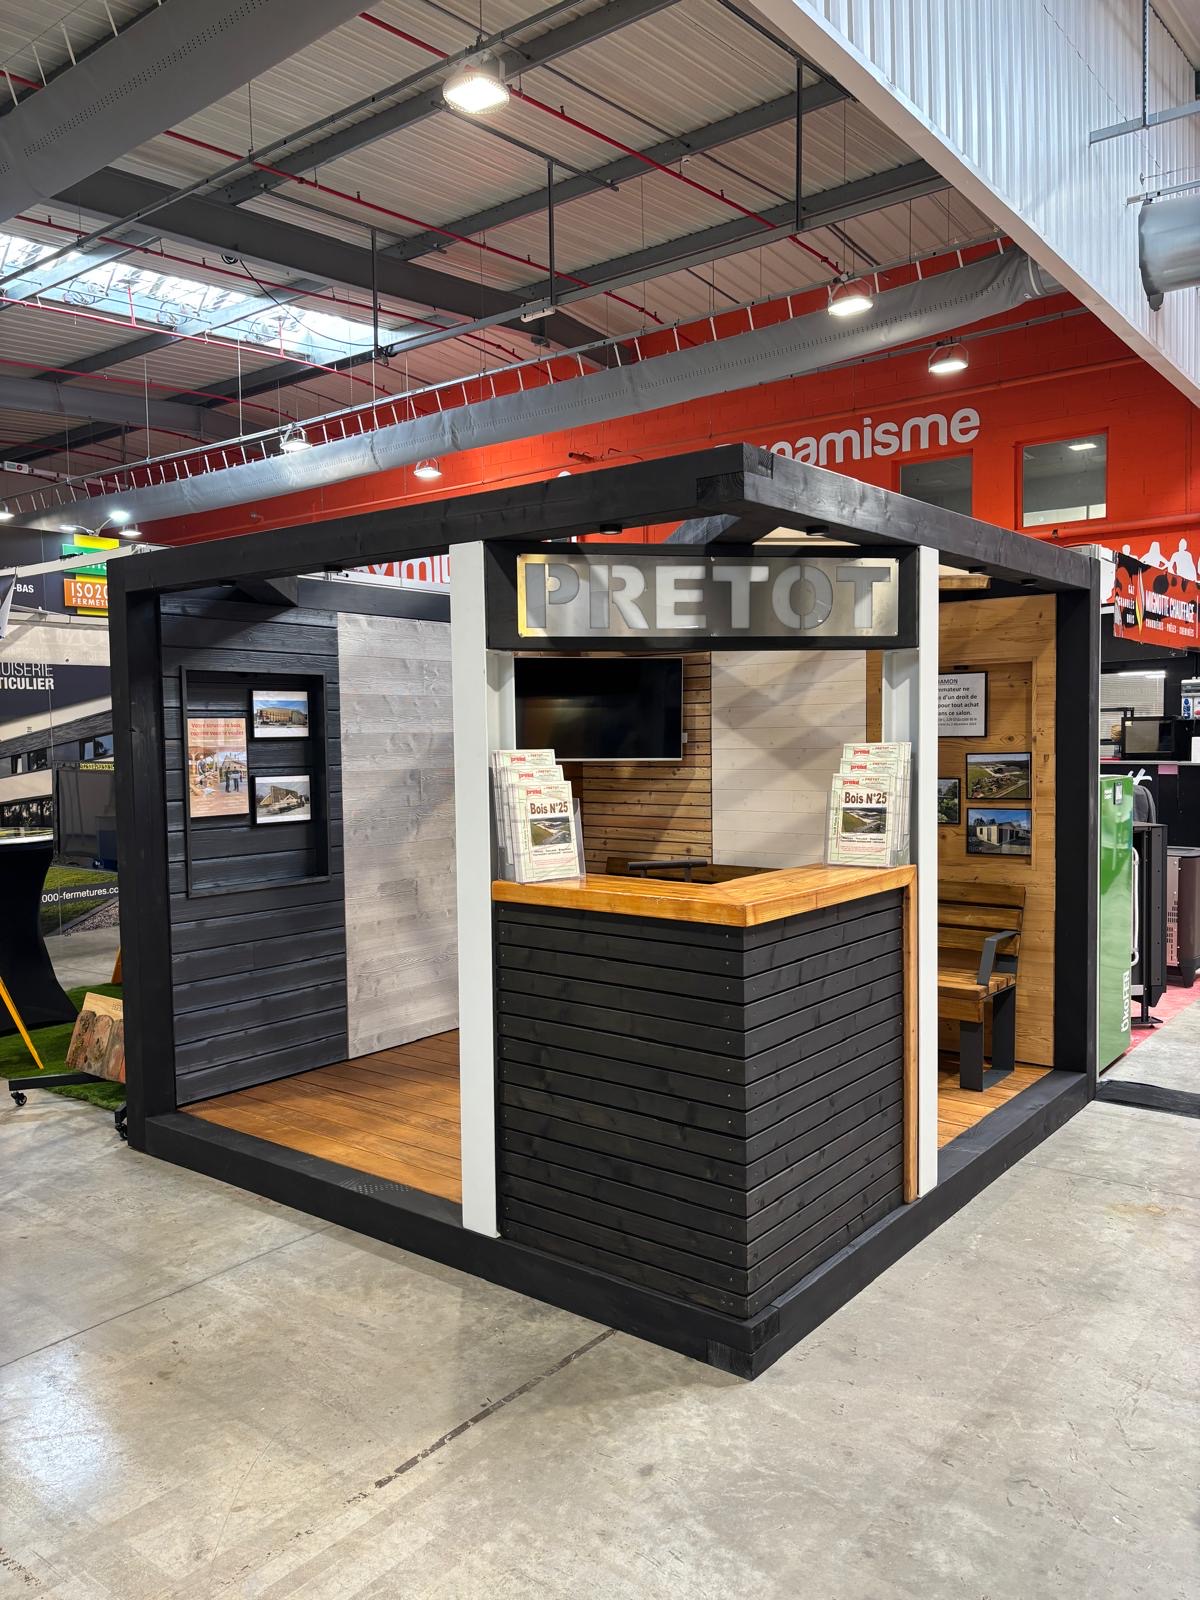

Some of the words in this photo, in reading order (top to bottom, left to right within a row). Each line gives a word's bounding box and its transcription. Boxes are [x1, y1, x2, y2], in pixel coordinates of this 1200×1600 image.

[524, 562, 892, 629] PRETOT
[845, 791, 864, 804] Bois
[866, 791, 887, 805] N°25
[530, 803, 548, 814] Bois
[550, 802, 568, 814] N°25
